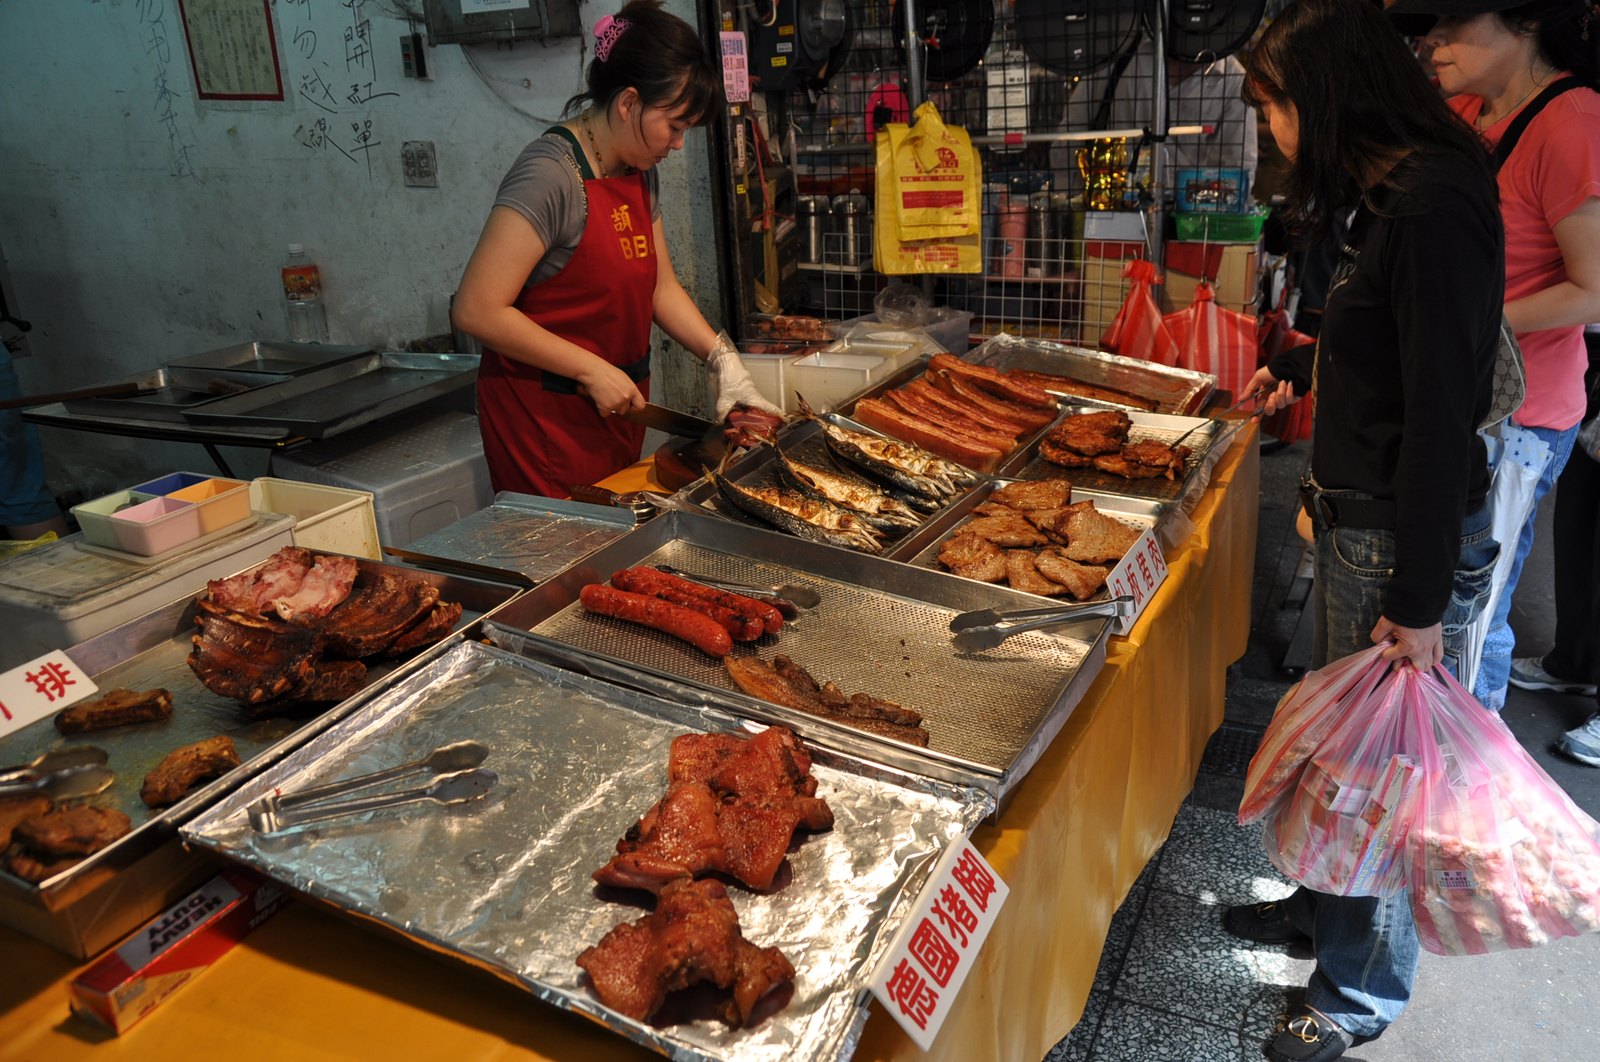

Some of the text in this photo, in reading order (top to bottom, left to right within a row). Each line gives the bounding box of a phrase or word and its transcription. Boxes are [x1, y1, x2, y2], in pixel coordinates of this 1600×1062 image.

[0, 661, 76, 720] 排
[147, 893, 206, 940] DUTY
[149, 895, 223, 954] HEAVY
